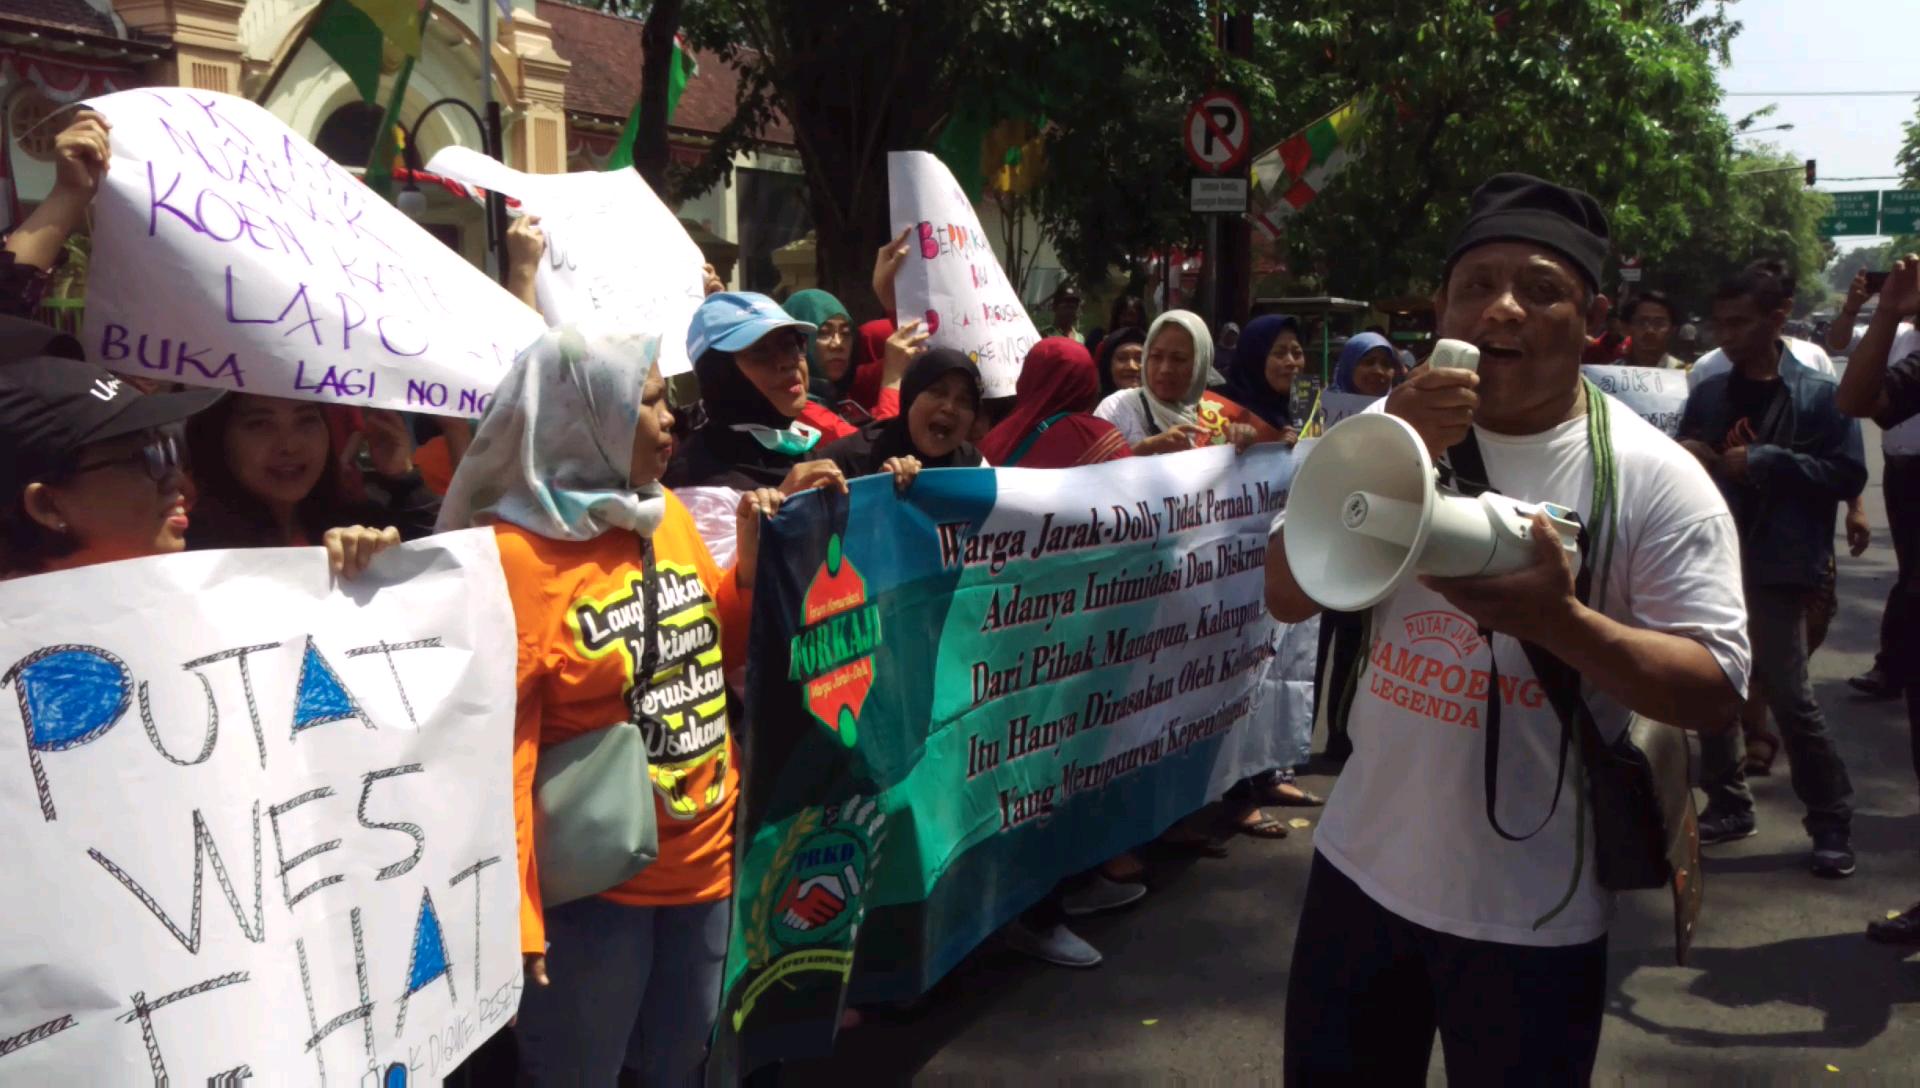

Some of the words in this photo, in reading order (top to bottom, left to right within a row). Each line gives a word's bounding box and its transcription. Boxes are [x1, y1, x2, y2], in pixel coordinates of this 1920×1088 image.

[101, 322, 245, 388] BUKA
[294, 361, 376, 398] LAGI
[407, 379, 449, 407] NO
[937, 521, 1026, 576] Warga
[1031, 501, 1162, 561] Jarak-Dolly
[1163, 492, 1203, 534] Tidak
[1205, 484, 1254, 524] Pernah
[1256, 480, 1289, 514] Mera
[981, 584, 1076, 633] Adanya
[1082, 558, 1183, 612] Intimidasi
[1185, 551, 1213, 589] Dan
[971, 651, 1025, 708] Dari
[1029, 635, 1097, 688] Pihak
[1406, 615, 1453, 639] PUTAT
[1451, 619, 1482, 656] JAYA
[0, 634, 446, 822] PUTAT
[966, 733, 1000, 780] Itu
[1006, 714, 1078, 757] Hanya
[1081, 674, 1176, 730] Dirasakan
[1178, 655, 1215, 695] Oleh
[1370, 672, 1481, 728] LEGENDA
[999, 784, 1057, 832] Yang
[87, 762, 426, 954] WES
